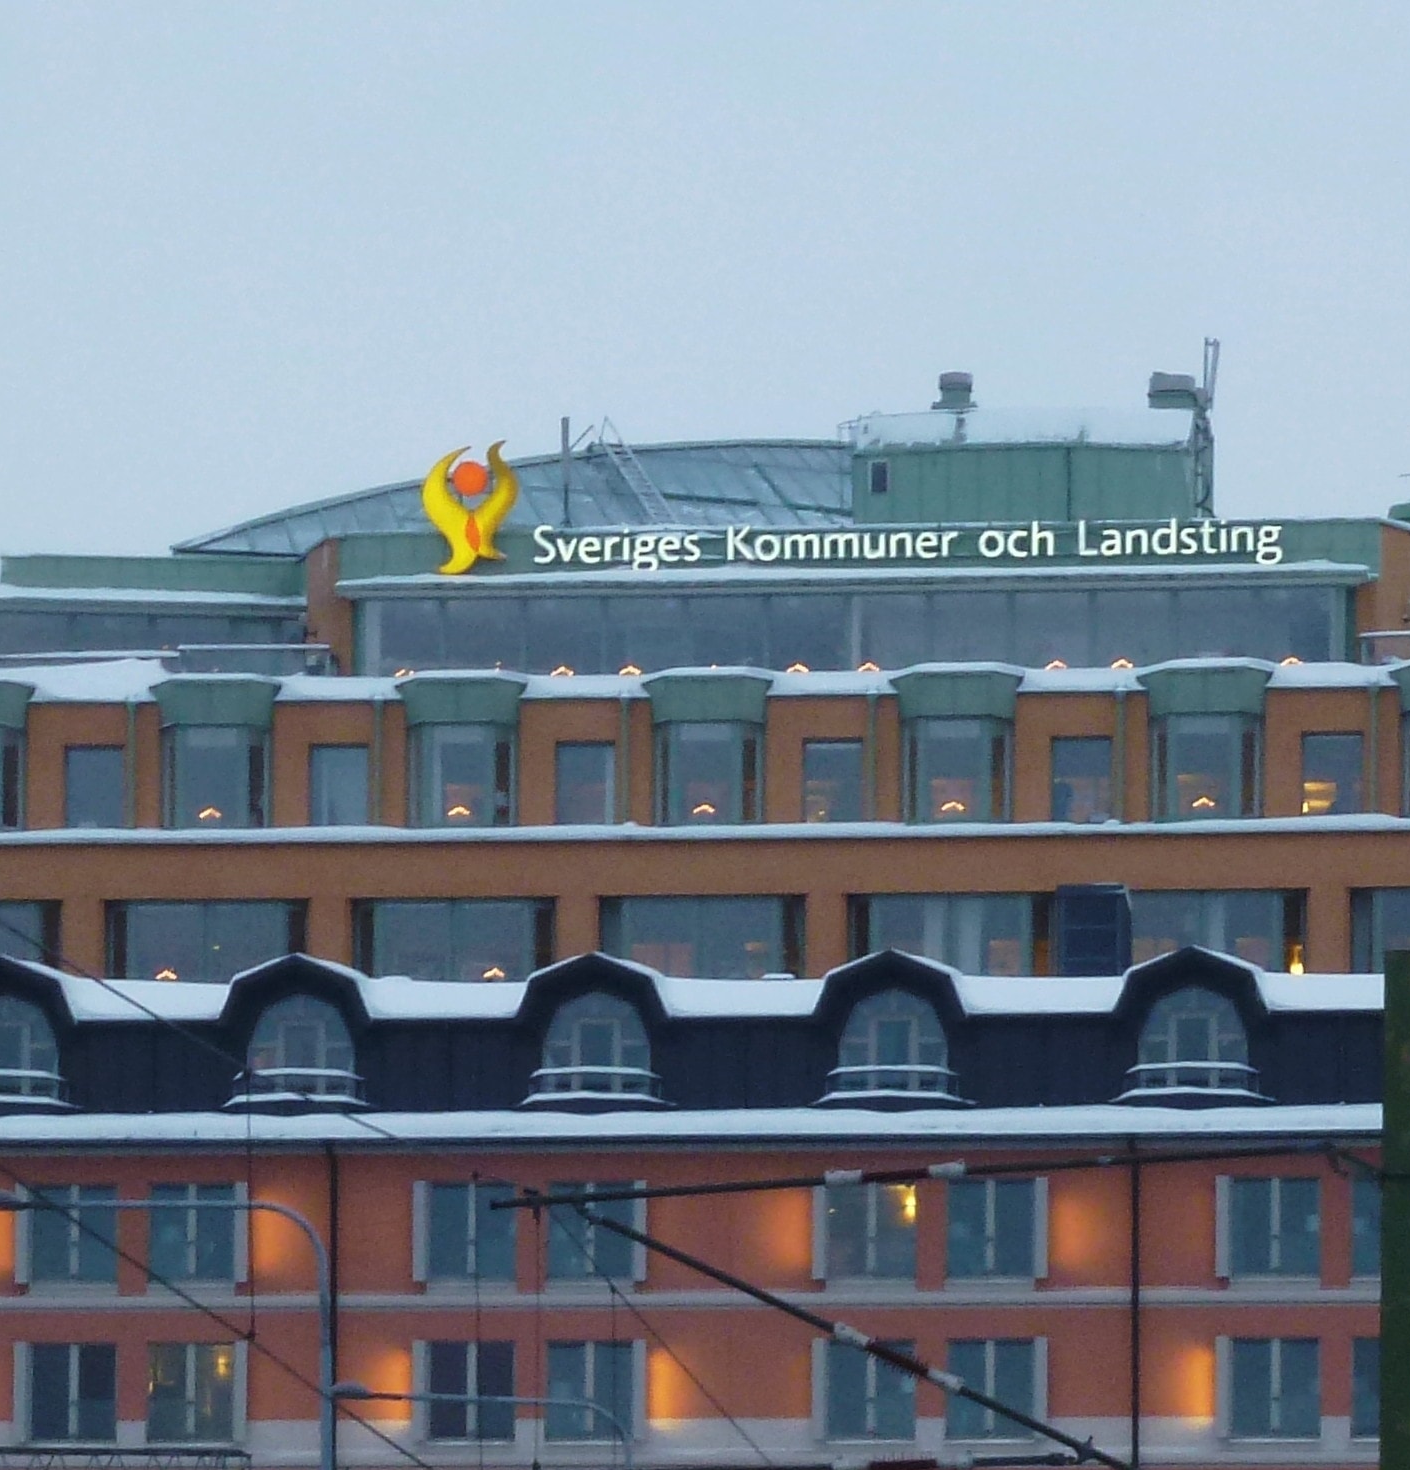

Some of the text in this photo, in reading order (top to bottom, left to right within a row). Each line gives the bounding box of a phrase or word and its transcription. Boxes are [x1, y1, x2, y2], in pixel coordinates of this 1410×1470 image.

[534, 518, 1282, 573] Sveriges Kommuner och Landsting
